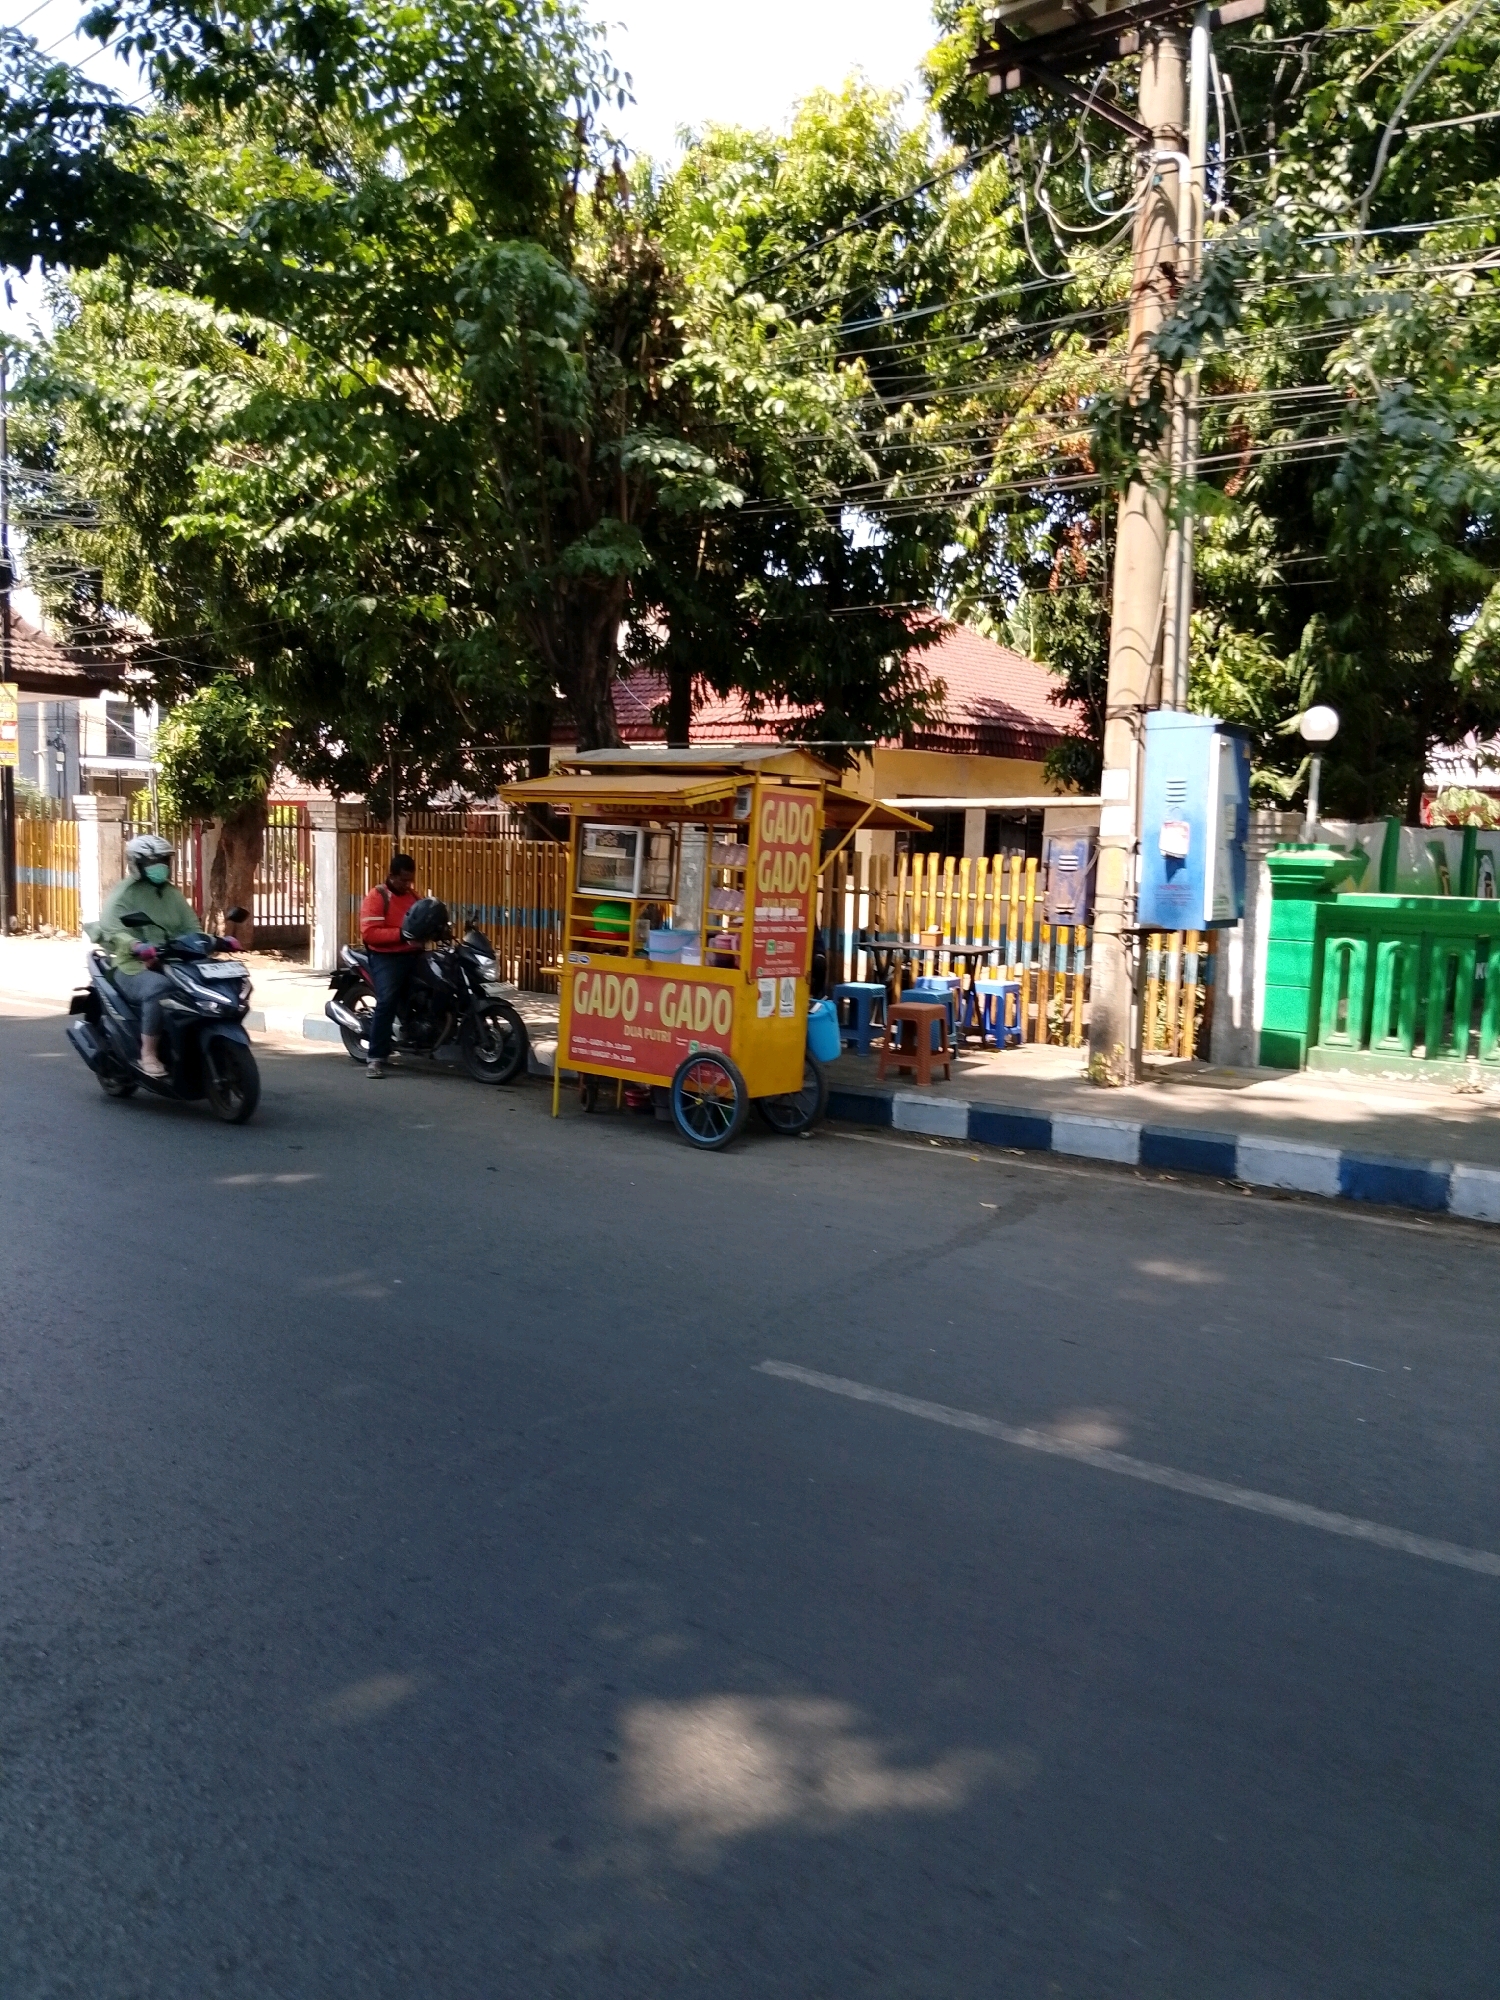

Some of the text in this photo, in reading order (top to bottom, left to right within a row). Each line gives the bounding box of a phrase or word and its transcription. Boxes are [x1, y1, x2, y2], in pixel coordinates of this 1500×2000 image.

[761, 799, 814, 846] GADO
[757, 850, 811, 894] GADO
[574, 971, 639, 1022] GADO
[659, 982, 732, 1036] GADO
[623, 1025, 643, 1039] DUA
[644, 1027, 672, 1043] PUTRI
